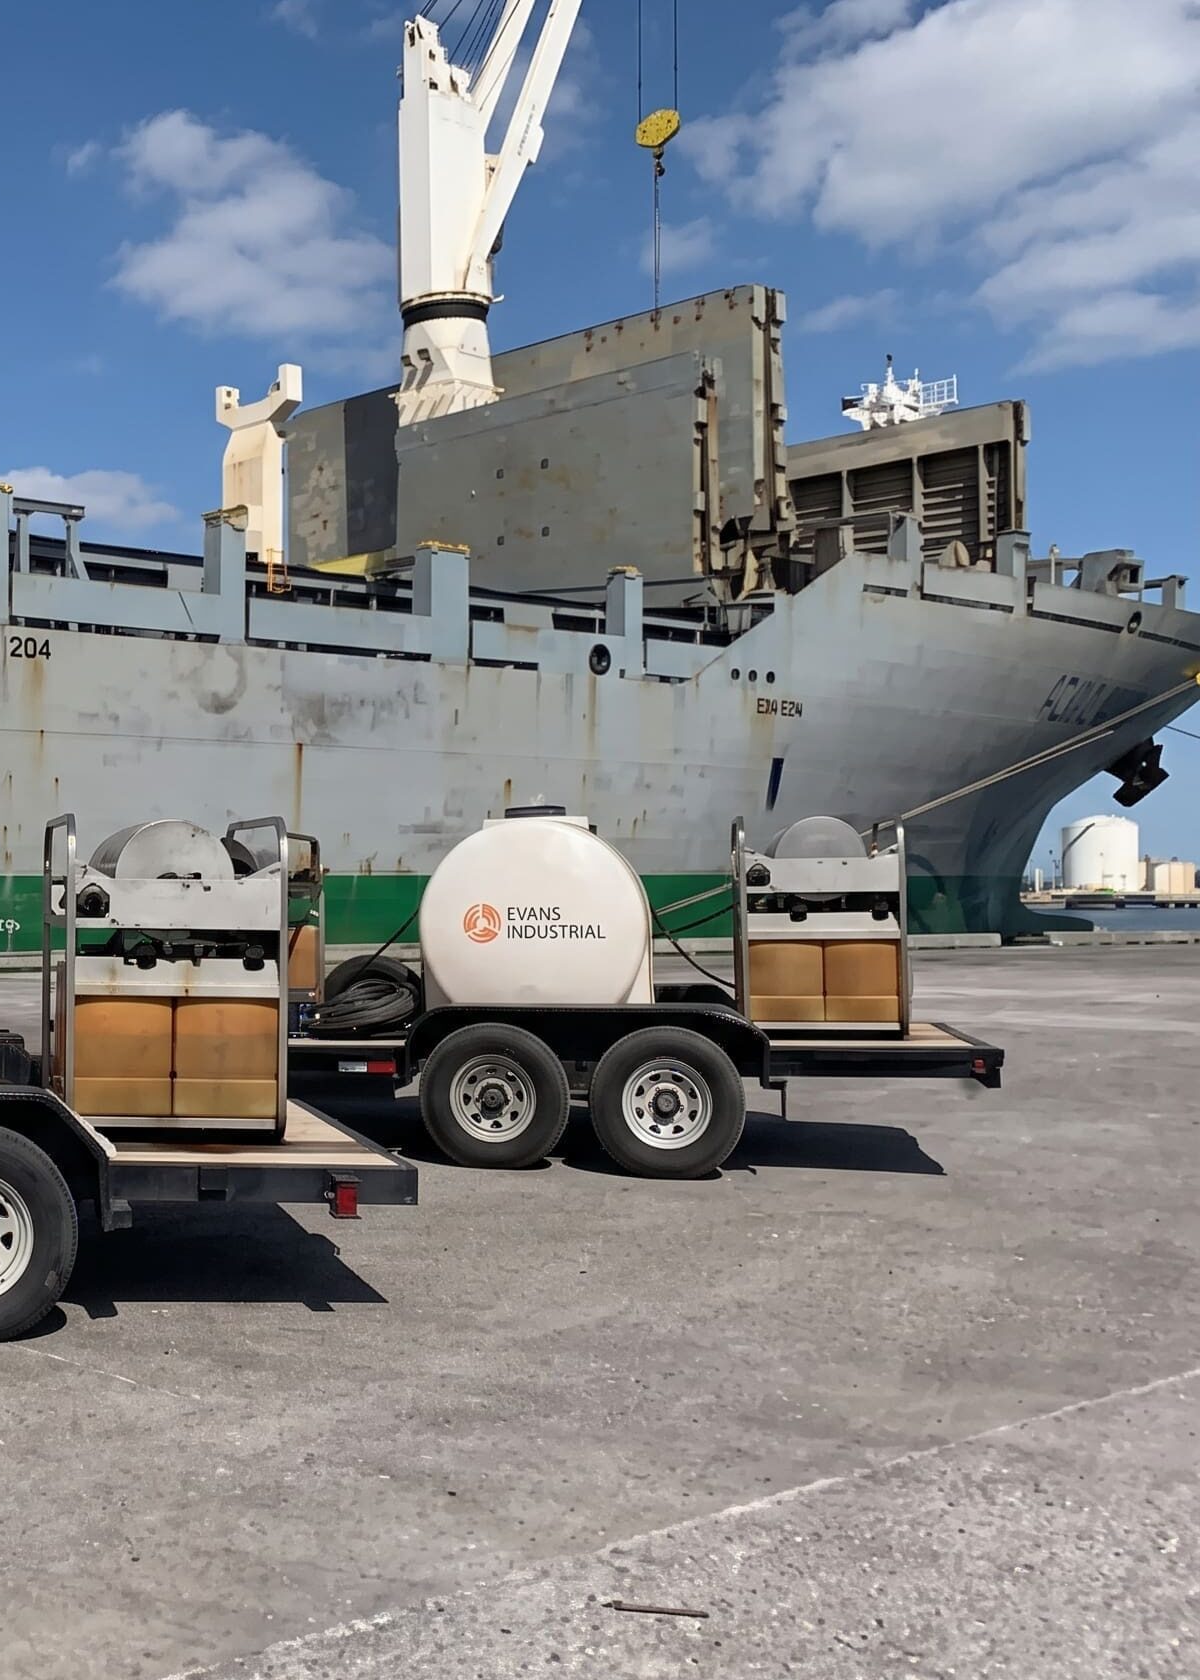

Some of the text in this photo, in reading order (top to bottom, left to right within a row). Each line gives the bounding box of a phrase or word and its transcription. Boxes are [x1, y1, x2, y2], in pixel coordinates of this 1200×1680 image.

[9, 636, 52, 660] 204
[507, 906, 561, 921] EVANS
[507, 924, 606, 939] INDUSTRIAL
